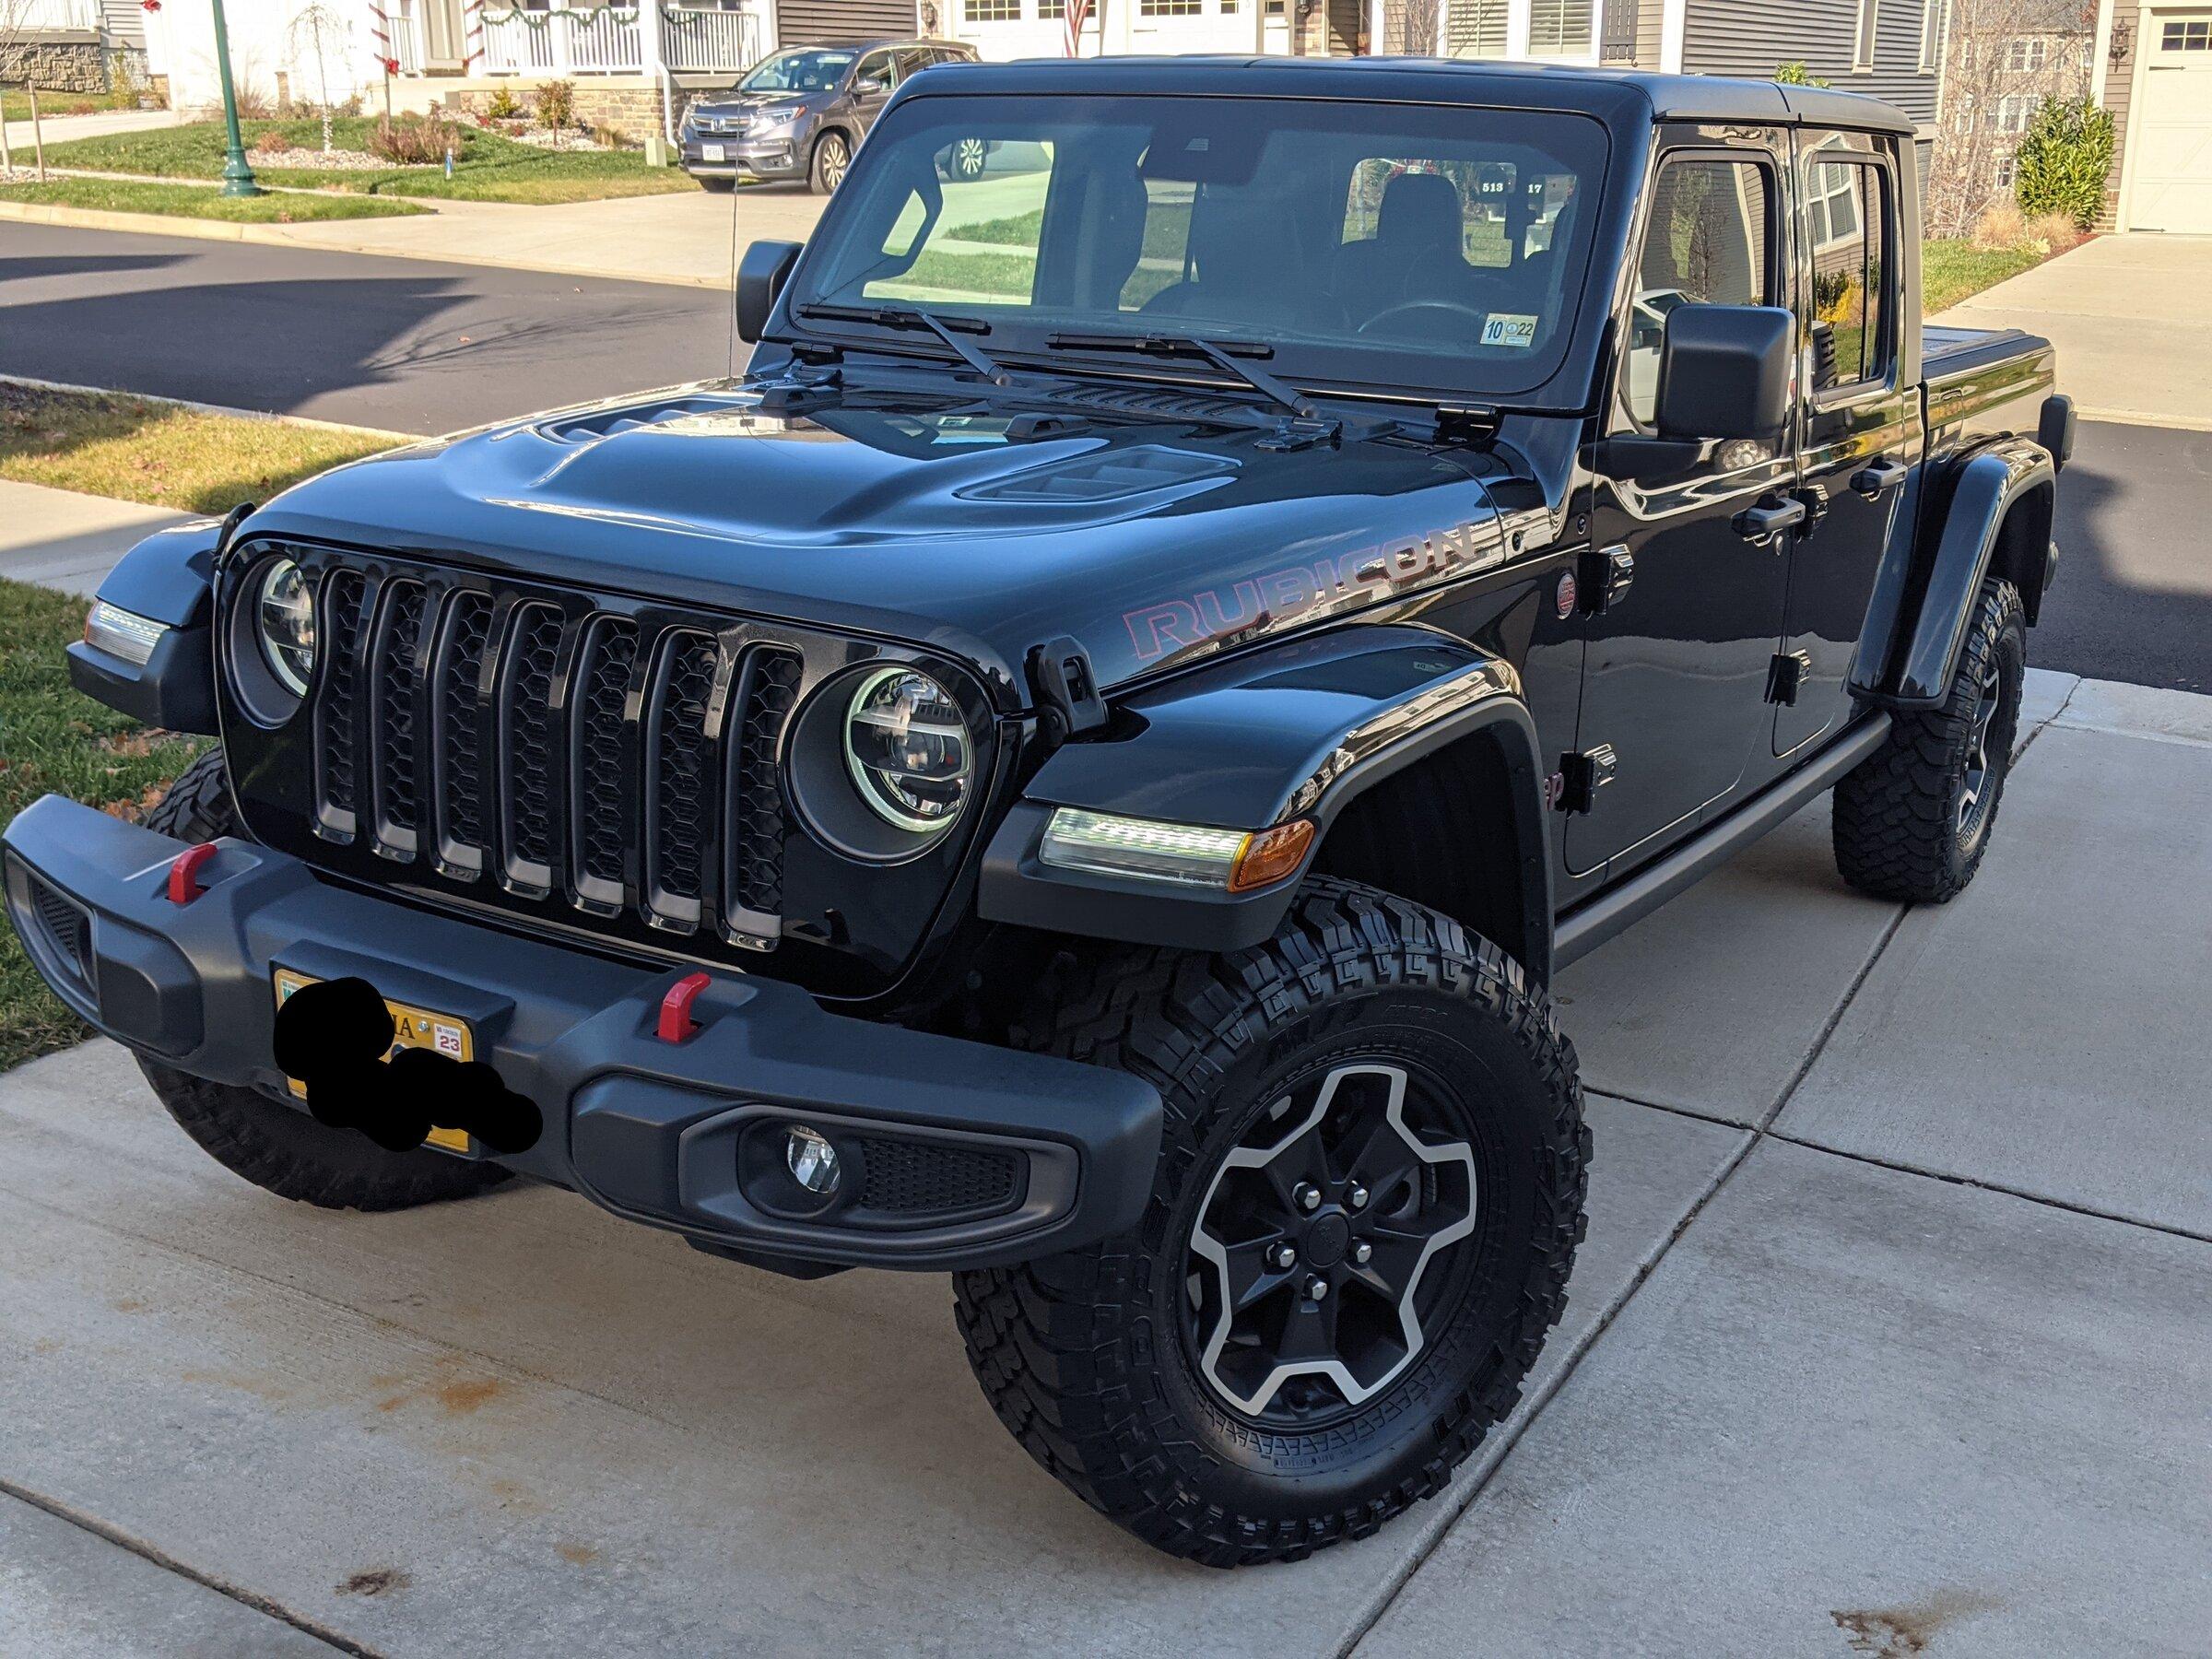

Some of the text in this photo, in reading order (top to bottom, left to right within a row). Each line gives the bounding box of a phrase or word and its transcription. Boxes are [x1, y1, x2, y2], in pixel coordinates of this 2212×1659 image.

[1482, 182, 1504, 193] 513
[1487, 321, 1534, 339] 10 22
[1122, 519, 1477, 660] RUBICON
[440, 1035, 460, 1052] 23
